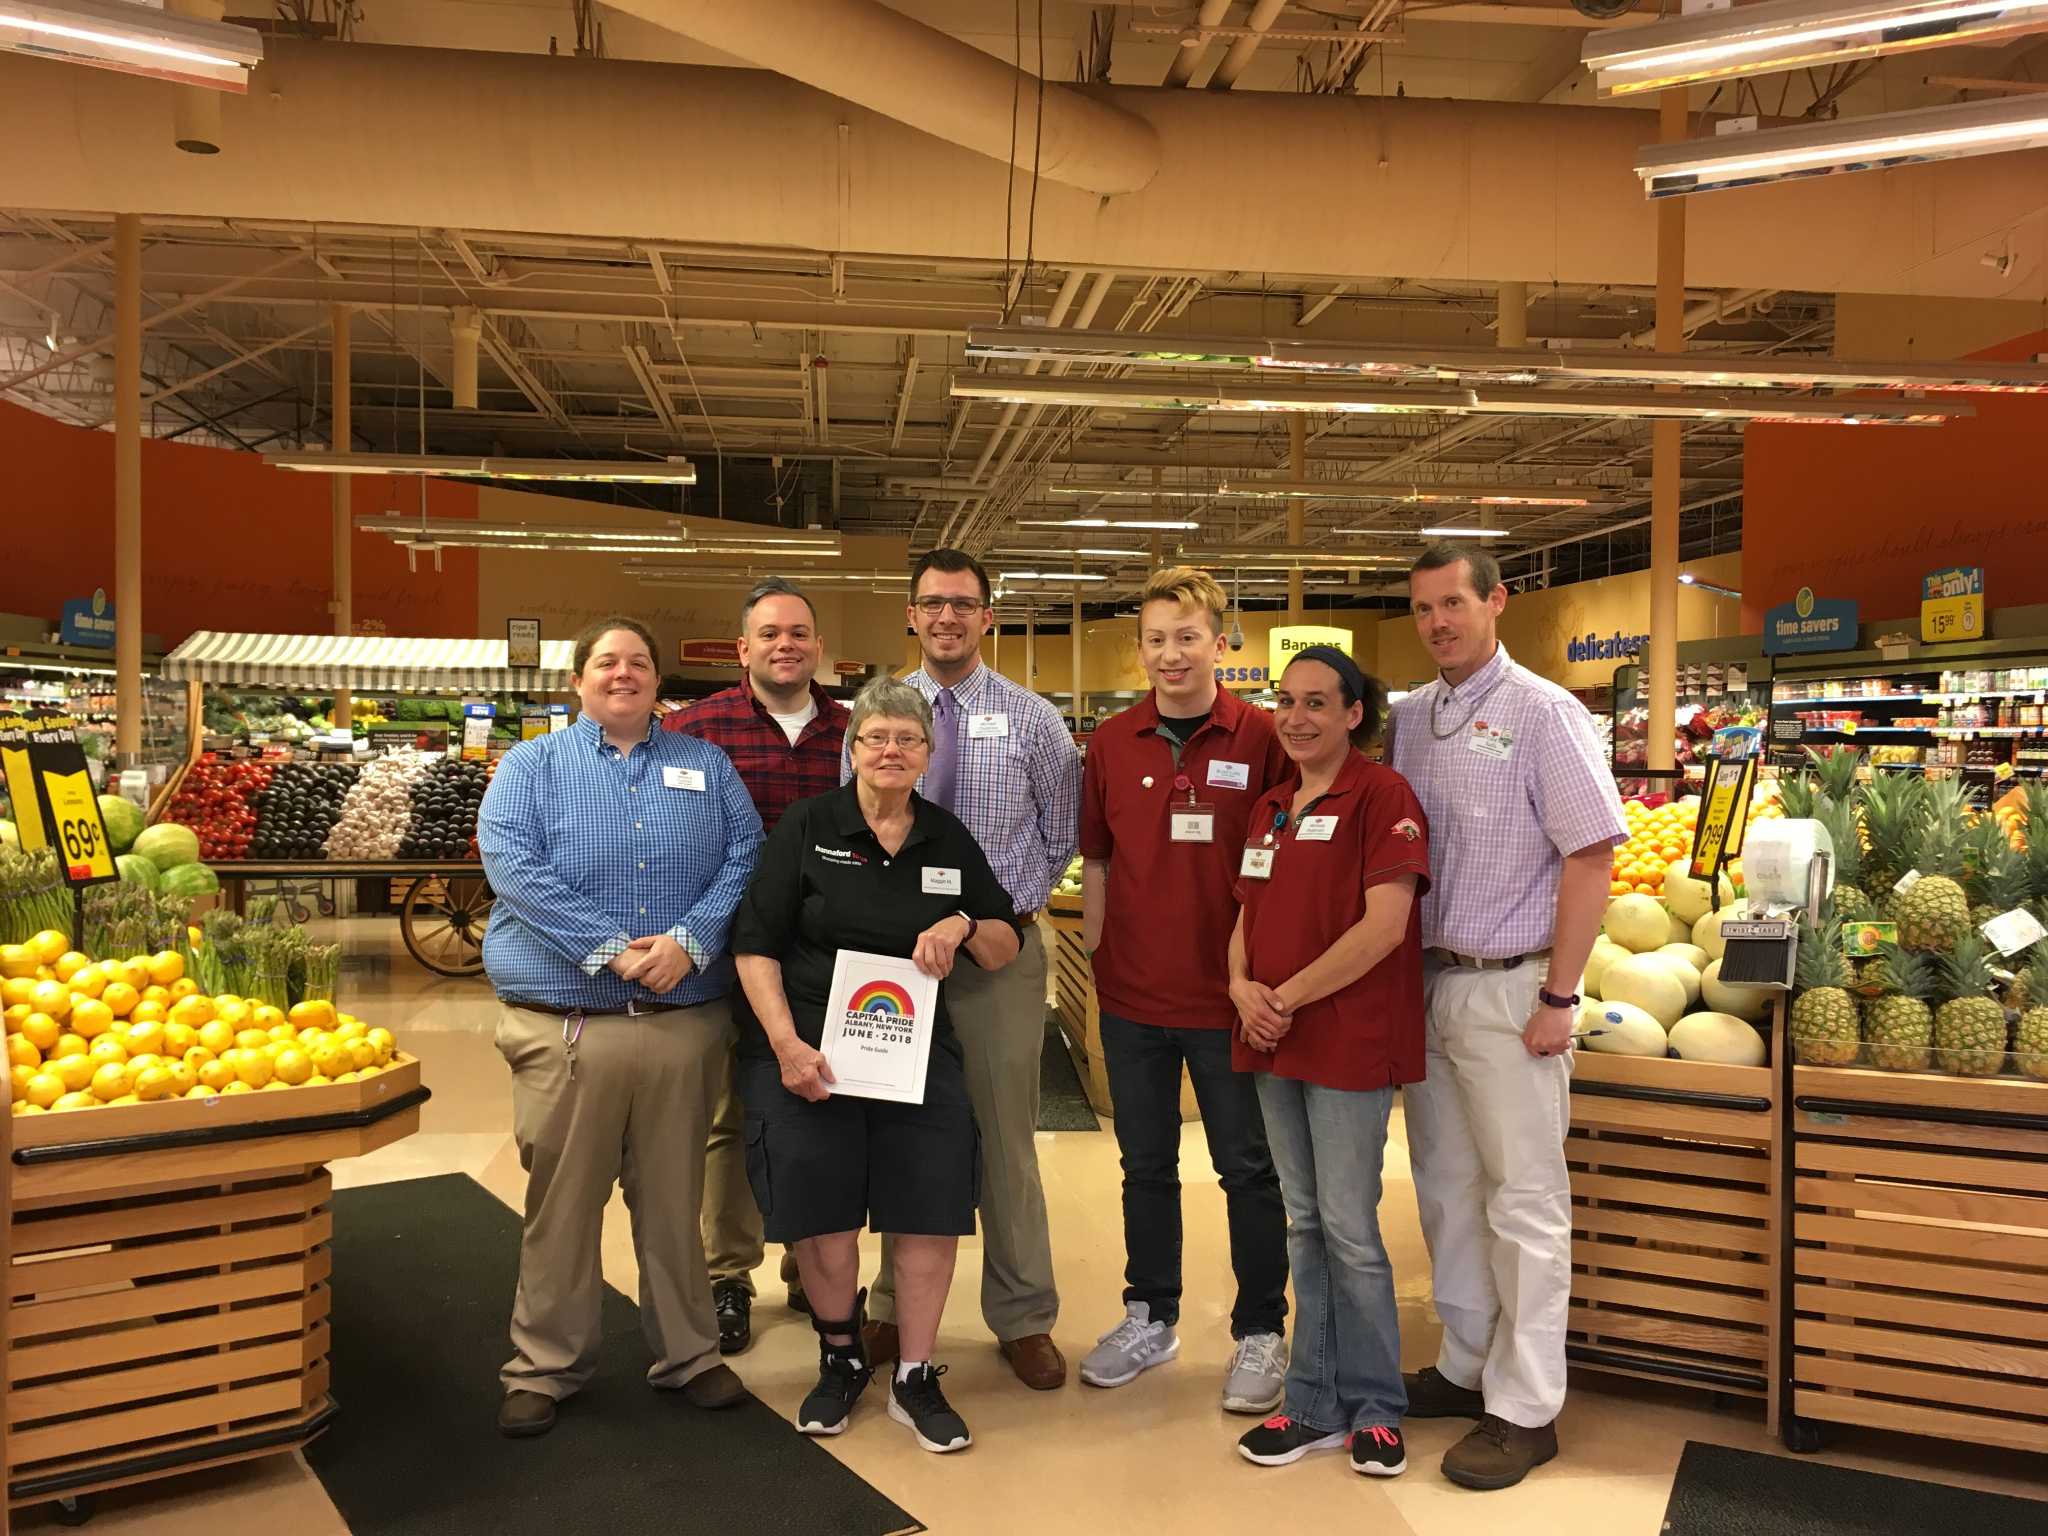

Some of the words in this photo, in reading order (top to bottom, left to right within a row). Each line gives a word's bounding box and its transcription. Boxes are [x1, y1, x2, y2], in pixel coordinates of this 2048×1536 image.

[1943, 568, 1980, 597] only!
[1776, 618, 1799, 636] time
[1800, 617, 1840, 634] savers
[32, 731, 60, 744] Every
[58, 728, 76, 744] Day
[815, 844, 852, 857] hannaford
[845, 1019, 875, 1030] ALBANY,
[876, 1023, 893, 1031] NEW
[894, 1026, 913, 1034] YORK
[846, 1011, 884, 1023] CAPITAL
[886, 1016, 915, 1027] PRIDE
[842, 1027, 873, 1039] JUNE
[882, 1033, 912, 1044] 2018
